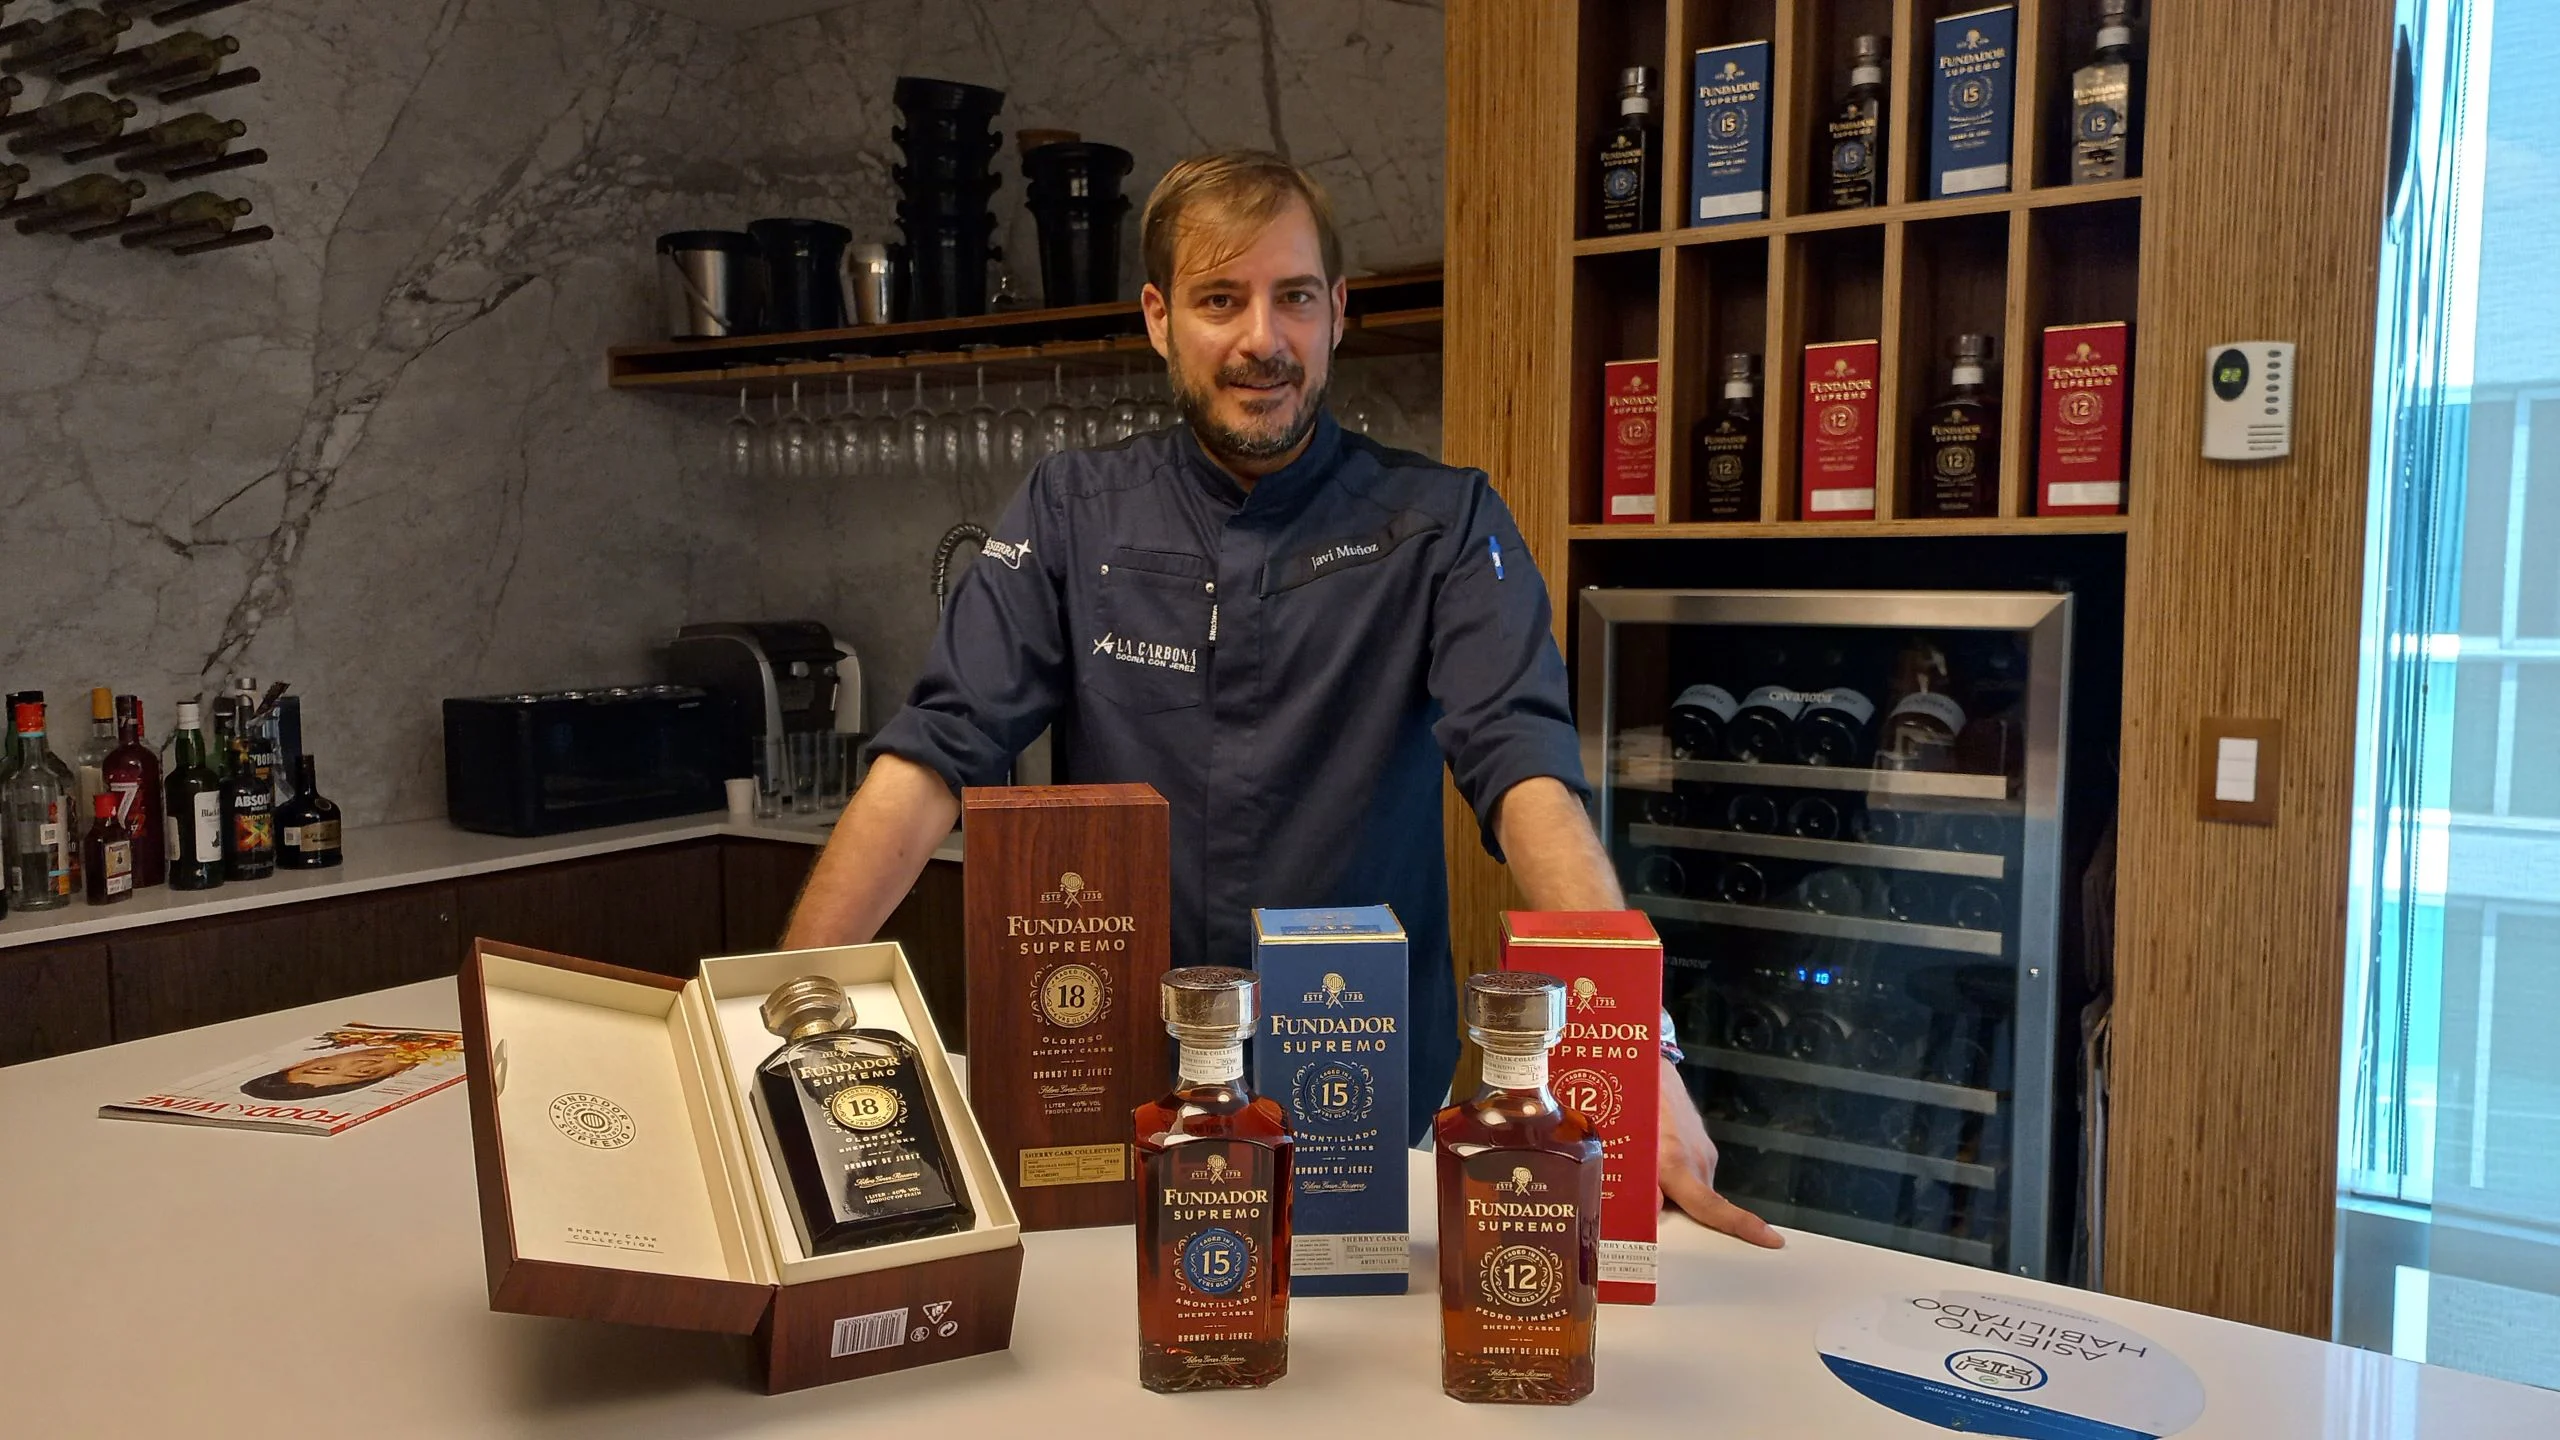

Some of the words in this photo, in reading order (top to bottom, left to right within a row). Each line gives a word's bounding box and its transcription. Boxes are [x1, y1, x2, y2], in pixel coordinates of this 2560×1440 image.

[1939, 48, 2006, 69] FUNDADOR
[1945, 60, 2001, 78] SUPREMO
[1700, 81, 1760, 98] FUNDADOR
[1963, 87, 1980, 103] 15
[1704, 93, 1756, 107] SUPREMO
[1721, 118, 1736, 132] 15
[2091, 117, 2107, 132] 15
[1844, 151, 1858, 164] 15
[1615, 178, 1628, 190] 15
[2048, 364, 2118, 380] FUNDADOR
[1809, 379, 1872, 394] FUNDADOR
[2053, 378, 2112, 389] SUPREMO
[1609, 395, 1657, 407] FUNDADO
[1815, 391, 1867, 403] SUPREMO
[2071, 402, 2089, 416] 12
[1830, 412, 1847, 427] 12
[1628, 426, 1642, 438] 12
[1932, 424, 1981, 436] FUNDADOR
[1704, 435, 1747, 446] FUNDADOR
[1947, 455, 1963, 468] 12
[1719, 464, 1732, 475] 12
[1311, 550, 1334, 570] Javi
[1336, 542, 1379, 560] Muñoz
[1117, 638, 1132, 655] LA
[1138, 641, 1197, 666] CARBONÁ
[1115, 653, 1145, 665] COCINA
[1147, 659, 1167, 667] CON
[1169, 662, 1196, 673] JEREZ
[110, 782, 139, 829] 7
[1082, 892, 1102, 900] 1730
[1007, 915, 1136, 937] FUNDADOR
[1020, 939, 1126, 955] SUPREMO
[1058, 984, 1085, 1008] 18
[1270, 1014, 1397, 1036] FUNDADOR
[1042, 1034, 1103, 1045] OLOROSO
[1283, 1039, 1386, 1054] SUPREMO
[1032, 1048, 1074, 1056] SHERRY
[1080, 1046, 1113, 1054] CASKS
[798, 1057, 901, 1080] FUNDADOR
[1033, 1070, 1067, 1080] BRANDY
[1072, 1069, 1082, 1077] DE
[1087, 1067, 1112, 1077] JEREZ
[813, 1069, 896, 1087] SUPREMO
[1322, 1082, 1348, 1107] 15
[1566, 1086, 1597, 1112] 12
[126, 1096, 232, 1114] WINE
[553, 1095, 628, 1121] FUNDADOR
[849, 1098, 879, 1117] 18
[245, 1106, 352, 1124] FOOD
[559, 1123, 630, 1147] SUPREMO
[845, 1130, 902, 1143] OLOROSO
[1293, 1129, 1377, 1142] AMONTILLADO
[839, 1142, 878, 1153] SHERRY
[883, 1137, 915, 1145] CASKS
[1295, 1145, 1335, 1153] SHERRY
[844, 1160, 877, 1170] BRANDY
[896, 1153, 920, 1162] JEREZ
[1025, 1151, 1053, 1159] SHERRY
[1295, 1166, 1329, 1175] BRANDY
[1333, 1166, 1343, 1174] DE
[1347, 1165, 1373, 1174] JEREZ
[1164, 1188, 1268, 1206] FUNDADOR
[1174, 1208, 1260, 1221] SUPREMO
[1468, 1199, 1575, 1219] FUNDADOR
[1478, 1220, 1567, 1232] SUPREMO
[567, 1227, 617, 1237] SHERRY
[625, 1234, 657, 1242] CASK
[573, 1235, 655, 1248] COLLECTION
[1203, 1236, 1221, 1244] AGED
[1507, 1249, 1526, 1257] AGED
[1202, 1250, 1230, 1275] 15
[1504, 1264, 1537, 1289] 12
[1175, 1295, 1257, 1308] AMONTILLADO
[1178, 1311, 1216, 1319] SHERRY
[1475, 1306, 1511, 1321] PEDRO
[1517, 1308, 1568, 1322] XIMÉNEZ
[1911, 1297, 2147, 1359] HABILITADO
[1178, 1334, 1210, 1342] BRANDY
[1215, 1333, 1224, 1341] DE
[1228, 1332, 1253, 1340] JEREZ
[1934, 1316, 2108, 1362] ASIENTO
[1483, 1347, 1516, 1355] BRANDY
[1520, 1347, 1530, 1355] DE
[1535, 1347, 1560, 1355] JEREZ
